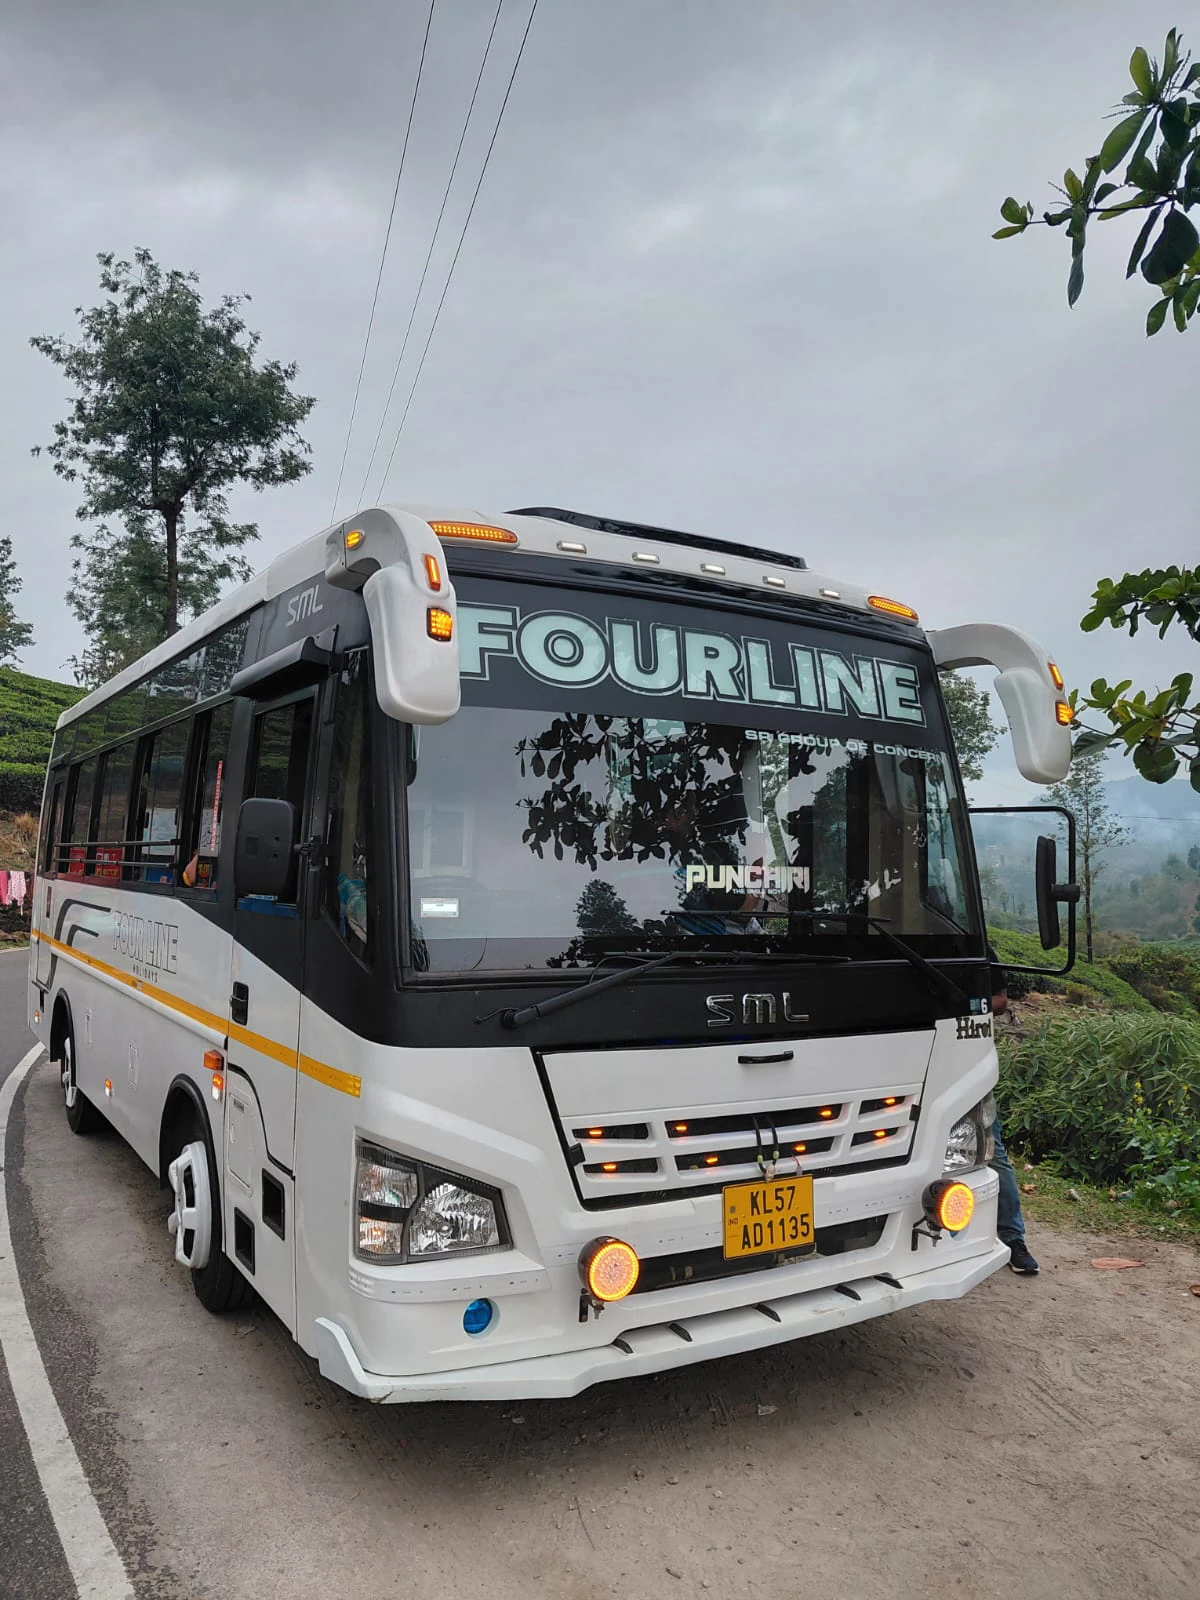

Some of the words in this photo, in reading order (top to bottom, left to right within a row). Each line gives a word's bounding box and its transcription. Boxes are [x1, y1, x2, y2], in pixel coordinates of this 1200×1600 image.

[285, 584, 323, 627] SML
[458, 601, 927, 728] FOURLINE
[778, 733, 840, 748] GROUP
[847, 739, 868, 752] OF
[874, 744, 945, 762] CONCERN
[686, 865, 810, 894] PUNCHIRI
[706, 992, 809, 1026] SML
[750, 1186, 796, 1216] KL57
[742, 1213, 810, 1250] AD1135
